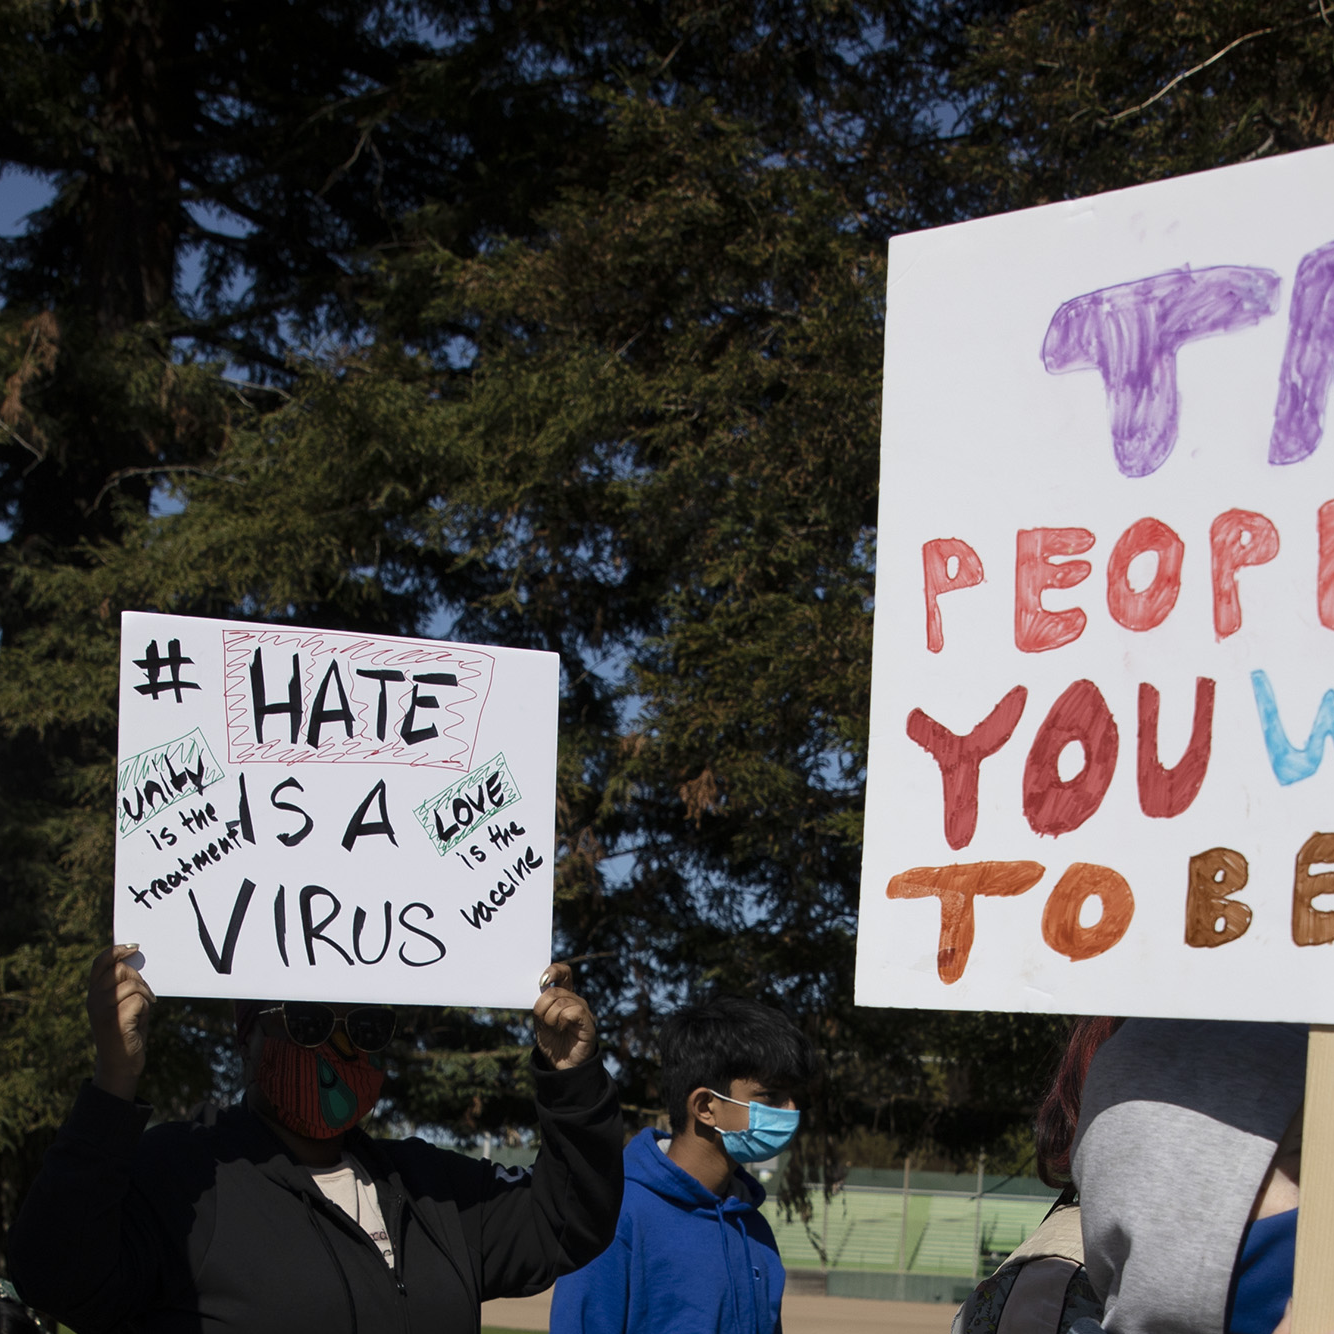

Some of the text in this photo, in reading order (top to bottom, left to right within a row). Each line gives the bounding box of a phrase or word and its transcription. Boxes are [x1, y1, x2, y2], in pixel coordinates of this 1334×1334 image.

[249, 646, 458, 750] HATE
[433, 771, 505, 842] LOVE
[906, 677, 1217, 850] YOU
[146, 803, 219, 850] is the
[237, 772, 399, 852] IS A
[456, 821, 526, 870] is the
[128, 821, 242, 909] treatment
[460, 846, 544, 930] vaccine
[188, 878, 446, 975] VIRUS
[885, 860, 1137, 985] TO
